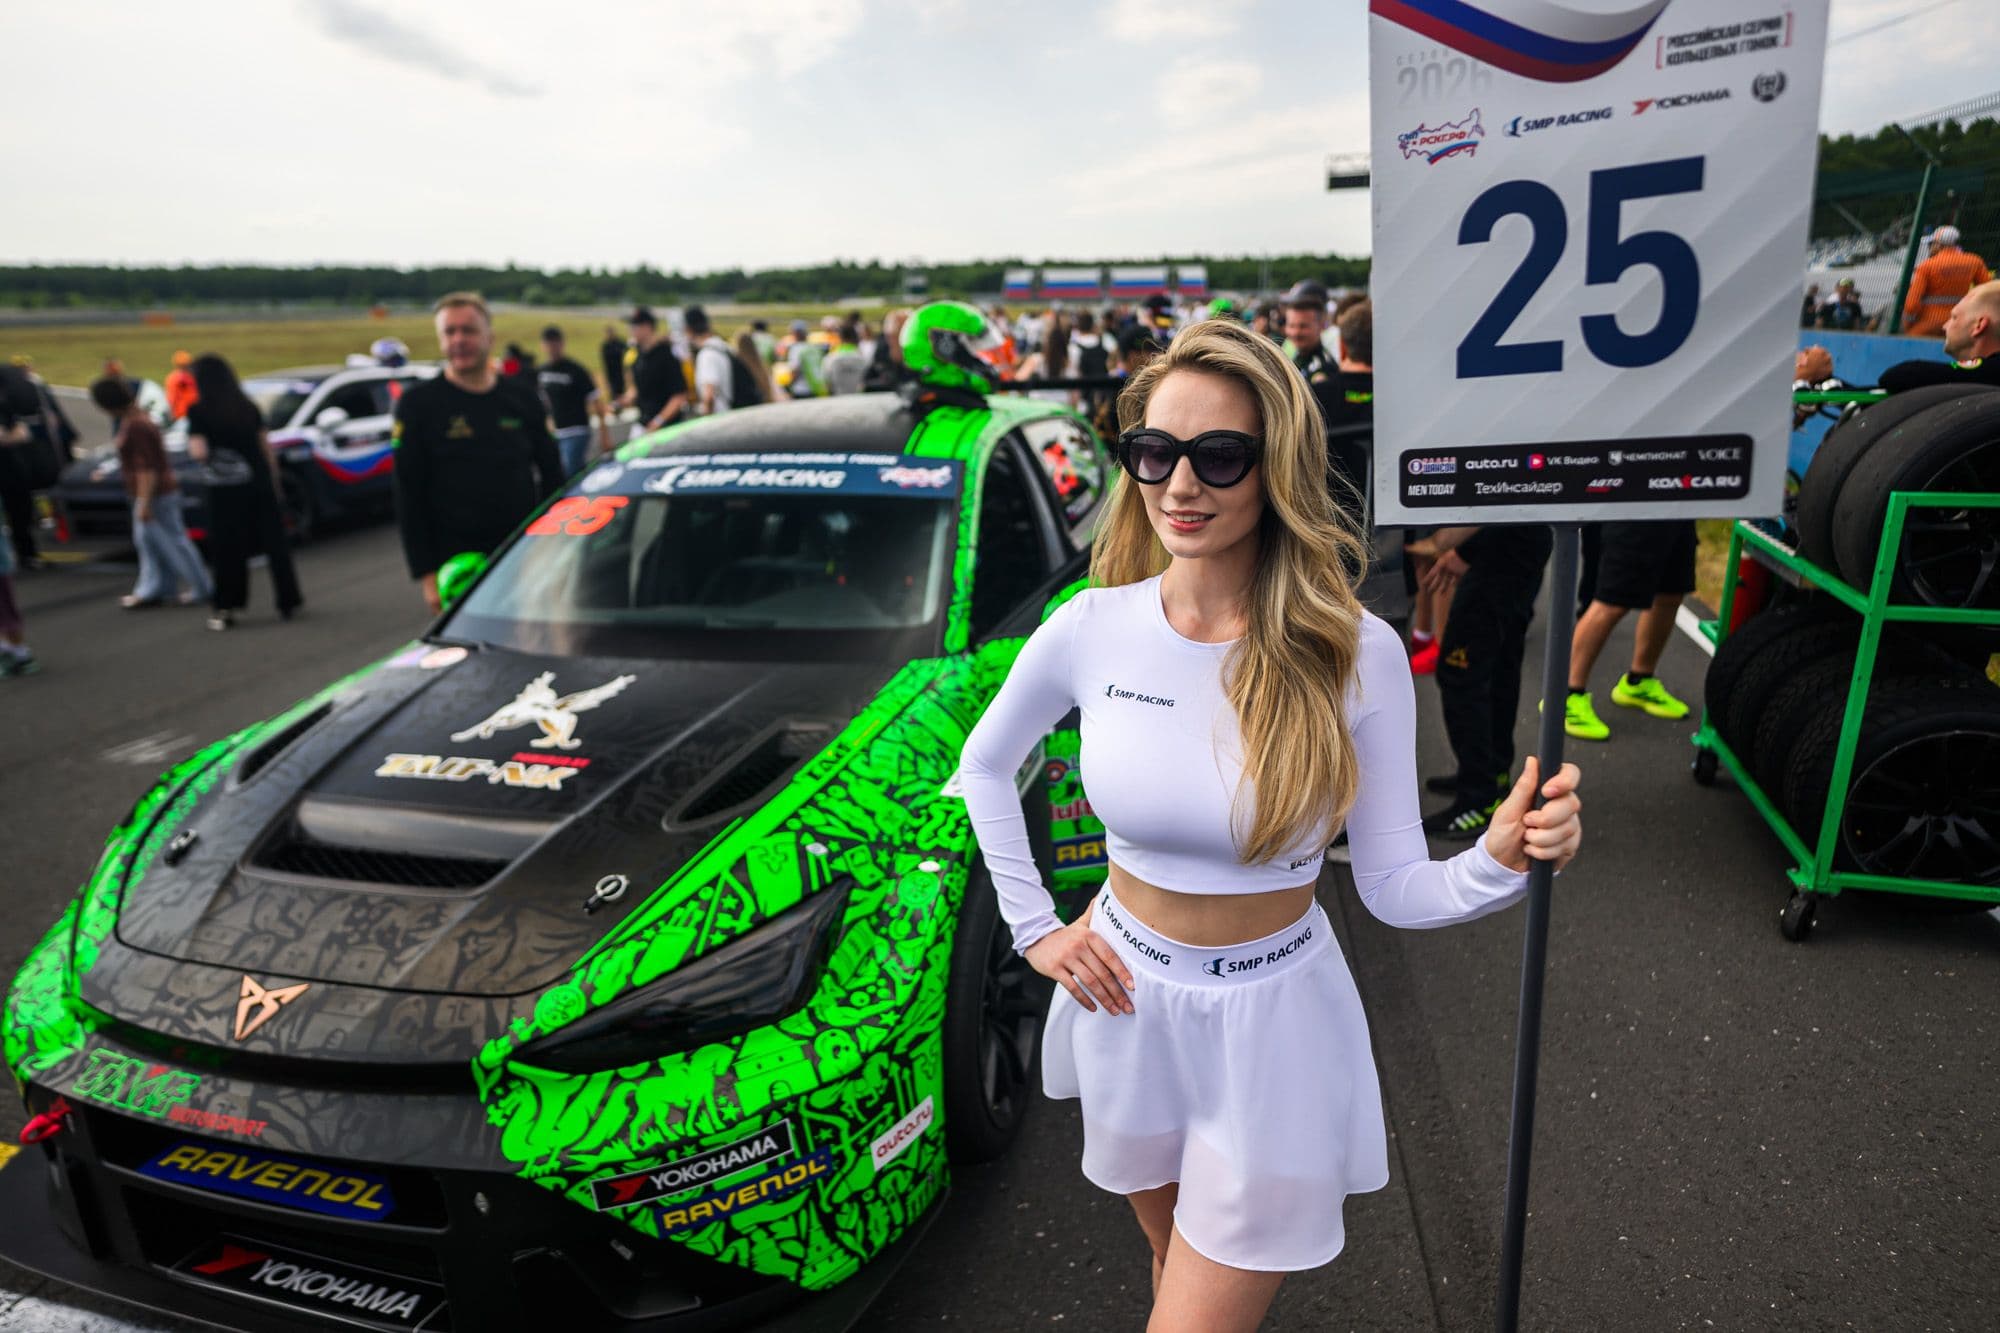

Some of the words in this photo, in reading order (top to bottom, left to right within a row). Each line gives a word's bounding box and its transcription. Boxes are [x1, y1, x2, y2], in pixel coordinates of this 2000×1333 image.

[1656, 88, 1731, 109] YOKOHAMA
[1523, 117, 1554, 132] SMP
[1556, 106, 1613, 127] RACING
[1456, 155, 1705, 379] 25
[1465, 459, 1518, 469] auto.ru
[1547, 457, 1562, 465] VK
[1563, 456, 1599, 465] Видео
[1698, 447, 1742, 460] VOICE
[677, 469, 739, 489] SMP
[736, 468, 847, 488] RACING
[1408, 484, 1427, 496] MEN
[1428, 484, 1456, 495] TODAY
[1475, 482, 1563, 495] ТехИнсайдер
[525, 495, 630, 535] 25
[1113, 689, 1136, 700] SMP
[1136, 693, 1175, 708] RACING
[1105, 906, 1123, 930] SMP
[1122, 930, 1171, 966] RACING
[1227, 957, 1263, 973] SMP
[1266, 926, 1313, 965] RACING
[168, 1105, 268, 1137] MOTORSPORT
[876, 1104, 931, 1158] auto.ru
[157, 1145, 387, 1211] RAVENOL
[650, 1135, 778, 1191] YOKOHAMA
[662, 1156, 828, 1230] RAVENOL
[249, 1258, 423, 1319] YOKOHAMA
